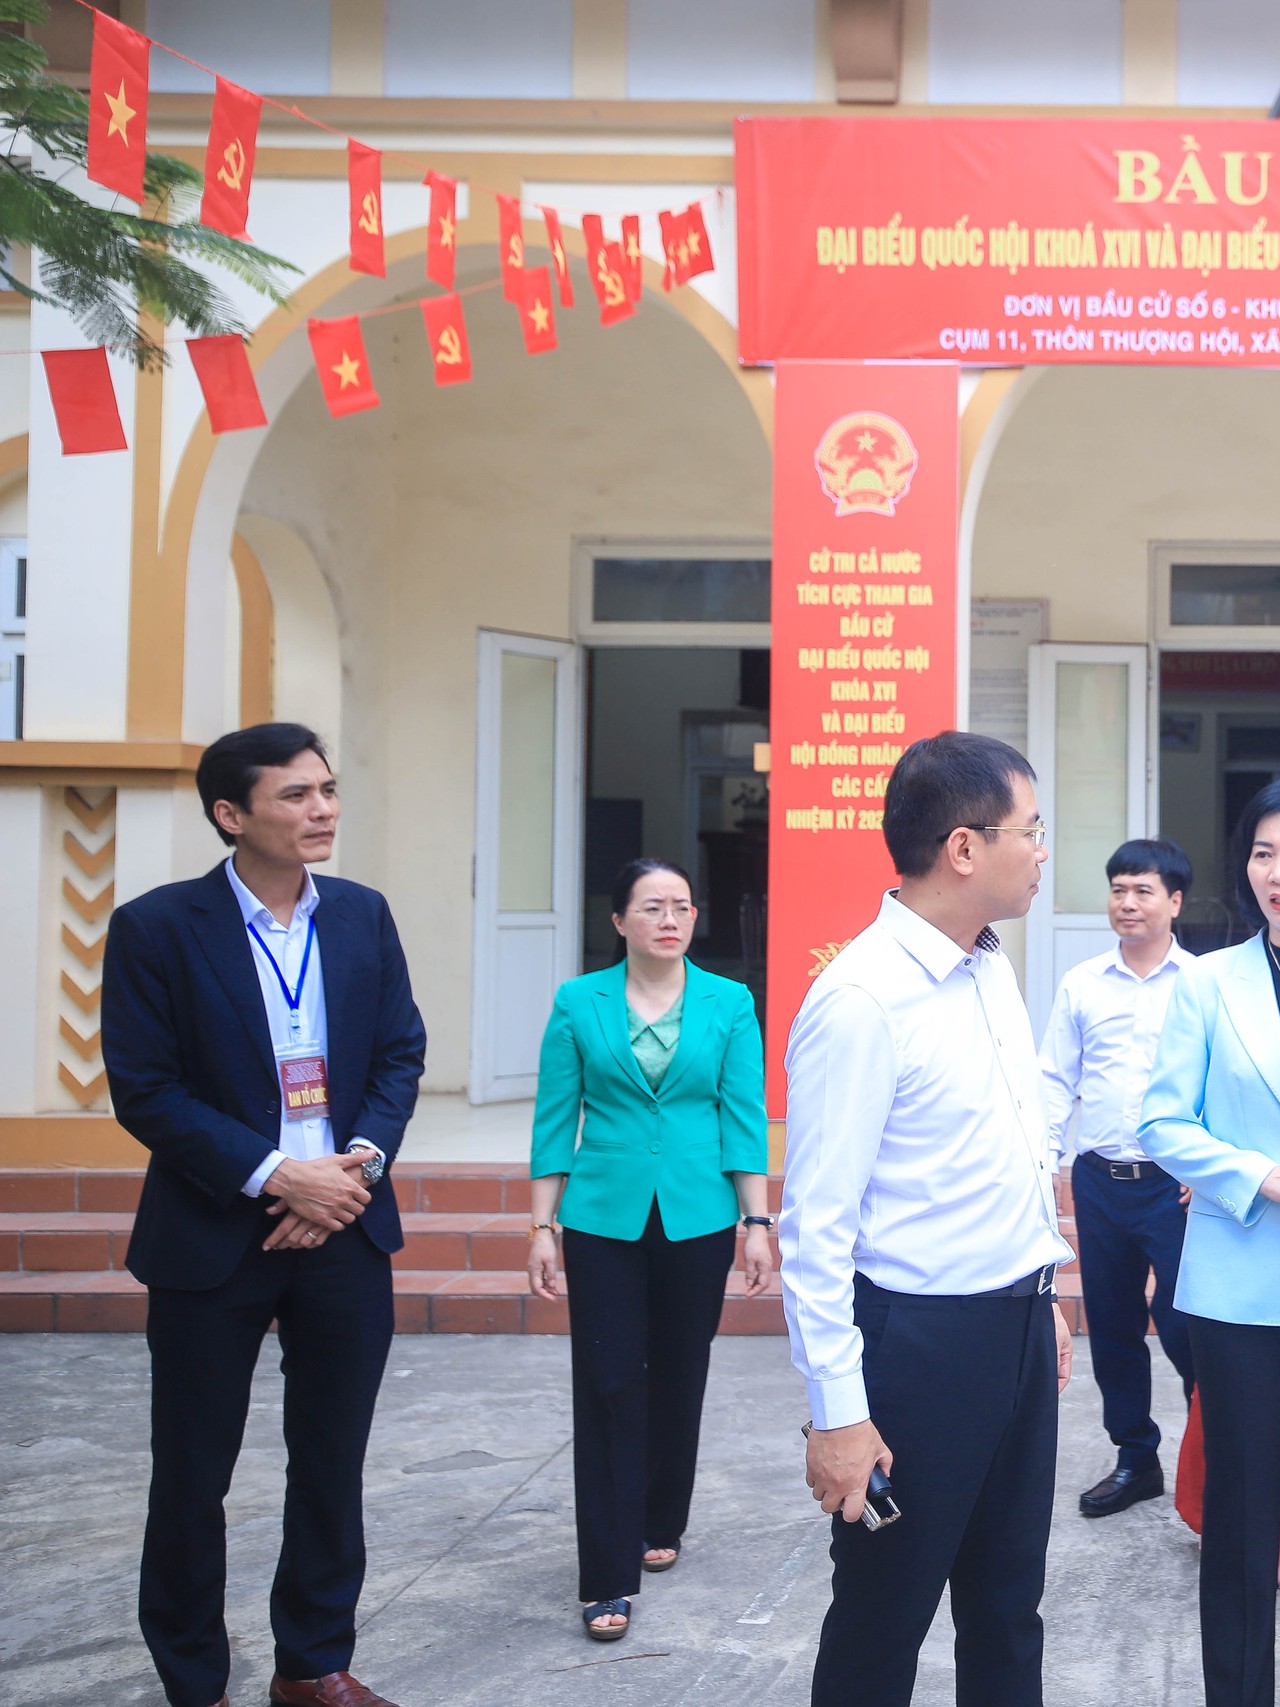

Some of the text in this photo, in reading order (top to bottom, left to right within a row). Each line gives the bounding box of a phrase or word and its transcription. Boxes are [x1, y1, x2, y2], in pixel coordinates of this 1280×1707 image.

[1112, 134, 1275, 206] BẦU
[816, 226, 857, 274] ĐẠI
[862, 212, 916, 266] BIỂU
[920, 214, 984, 271] QUỐC
[989, 220, 1029, 275] HỘI
[1034, 221, 1098, 268] KHOÁ
[1101, 229, 1141, 268] XVI
[1145, 222, 1177, 269] VÀ
[1181, 230, 1222, 277] ĐẠI
[1226, 216, 1280, 270] BIỂU
[1003, 293, 1053, 317] ĐƠN
[1058, 295, 1081, 321] VỊ
[1086, 288, 1133, 318] BẦU
[1138, 289, 1172, 318] CỬ
[1175, 289, 1209, 318] SỐ
[1212, 298, 1226, 319] 6
[939, 328, 990, 354] CỤM
[996, 329, 1027, 353] 11,
[1031, 324, 1094, 351] THÔN
[1099, 328, 1194, 355] THƯỢNG
[1200, 326, 1245, 356] HỘI,
[1250, 327, 1280, 353] XÃ
